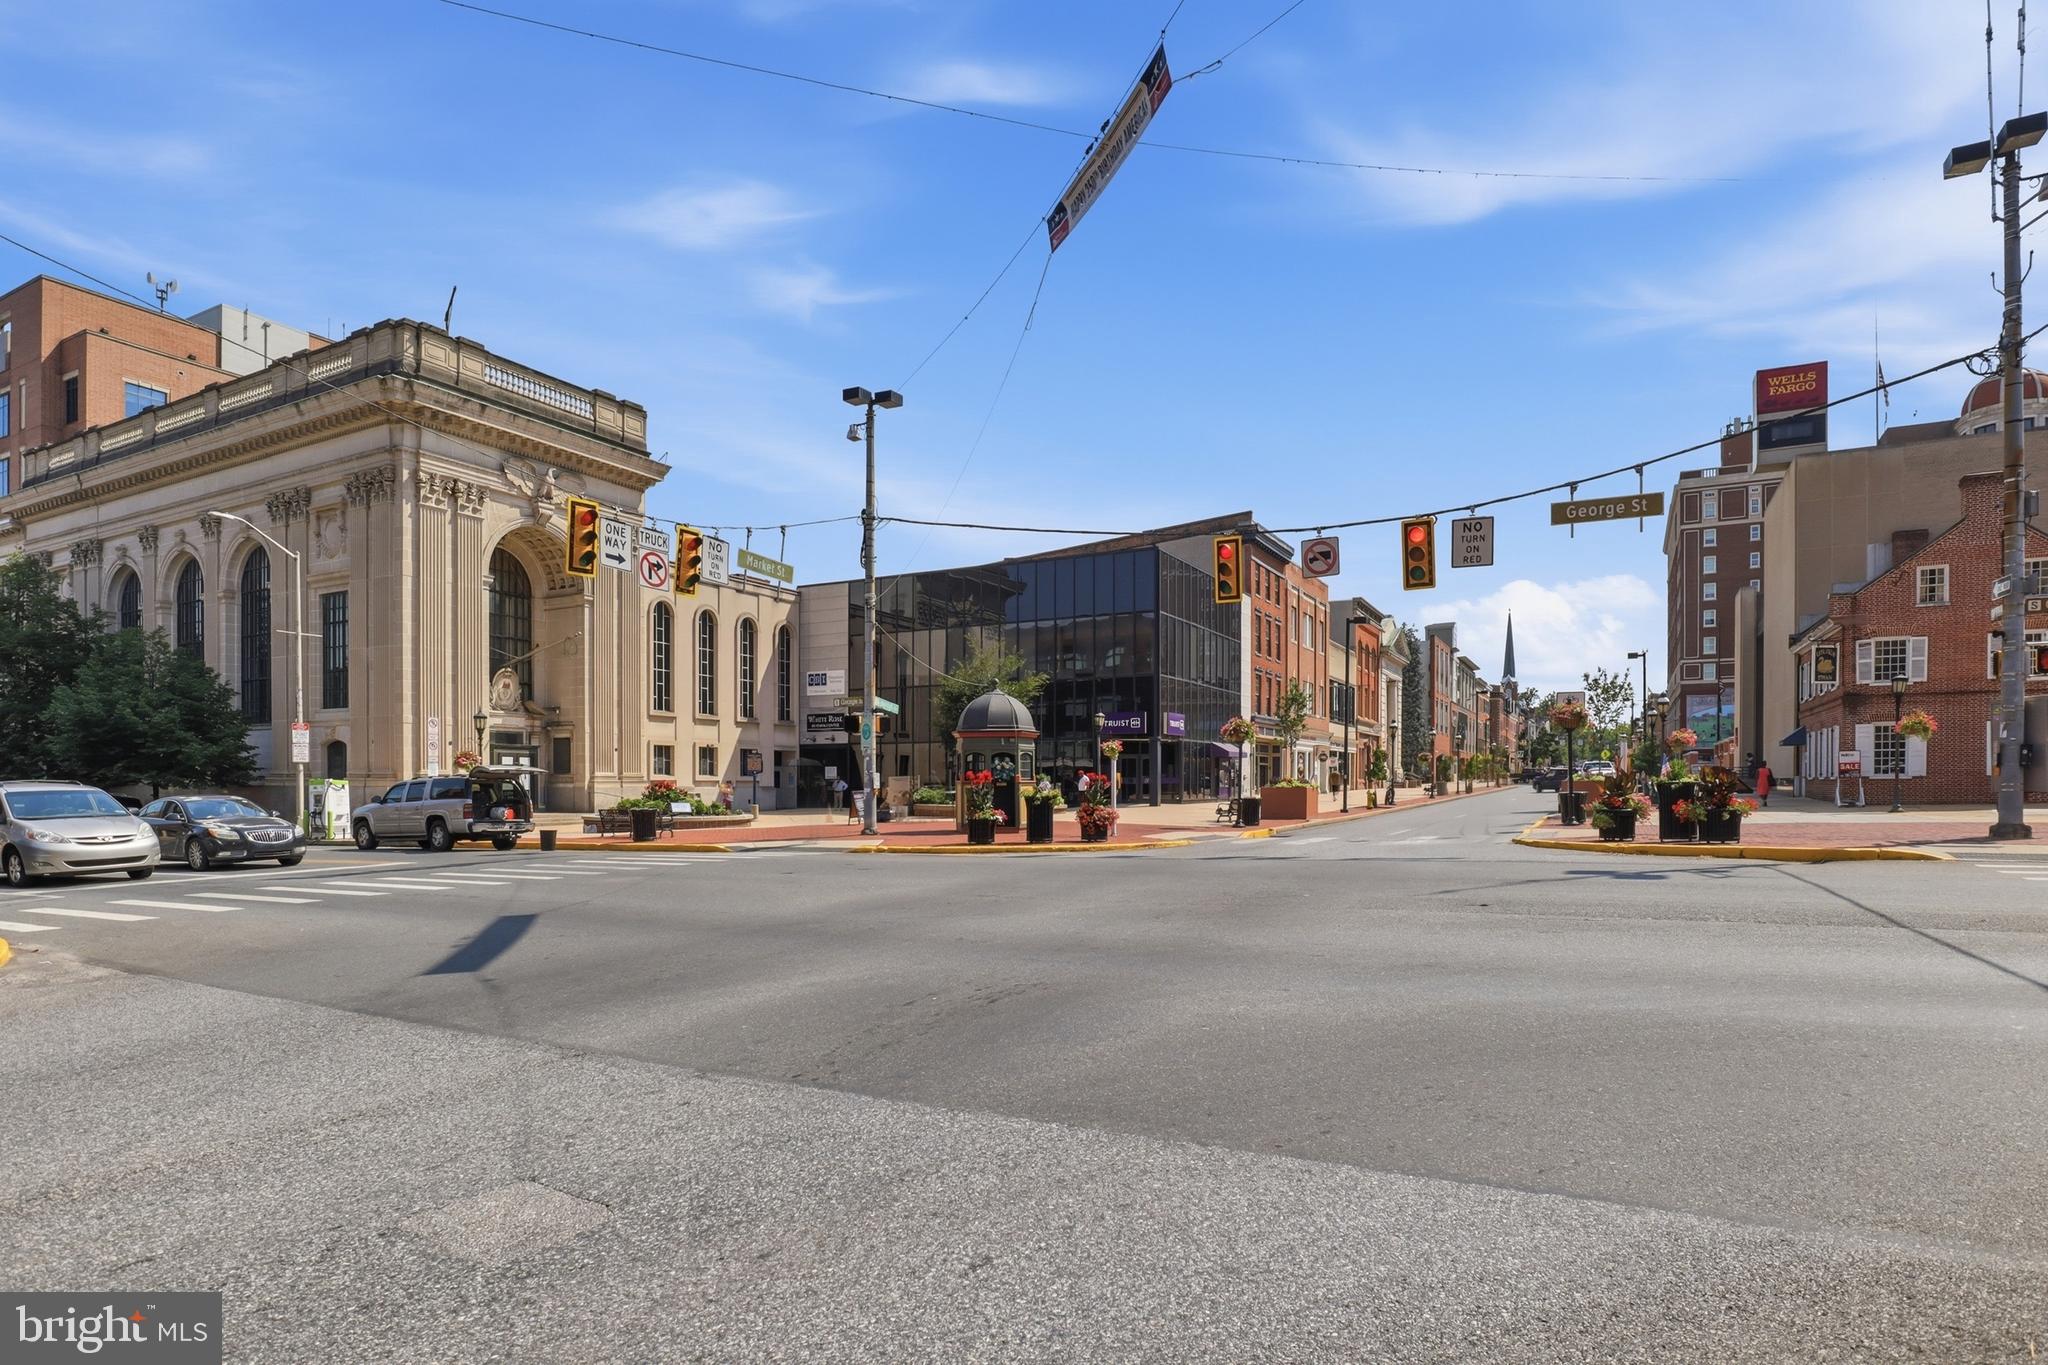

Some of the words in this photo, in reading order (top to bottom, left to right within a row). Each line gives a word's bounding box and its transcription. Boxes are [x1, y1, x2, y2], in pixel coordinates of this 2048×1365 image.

[1768, 371, 1817, 386] WELLS
[1769, 381, 1816, 396] FARGO
[1566, 503, 1625, 519] George
[1631, 497, 1648, 512] St
[605, 523, 627, 539] ONE
[1462, 521, 1482, 533] NO
[604, 534, 627, 551] WAY
[640, 530, 668, 549] TRUCK
[1461, 534, 1486, 543] TURN
[708, 541, 723, 554] NO
[1465, 545, 1480, 554] ON
[707, 551, 724, 563] TURN
[1463, 555, 1482, 564] RED
[711, 561, 720, 571] ON
[746, 555, 771, 575] Market
[771, 564, 785, 578] St
[708, 570, 722, 580] RED
[2030, 601, 2039, 609] S
[1104, 719, 1130, 727] TRUIST
